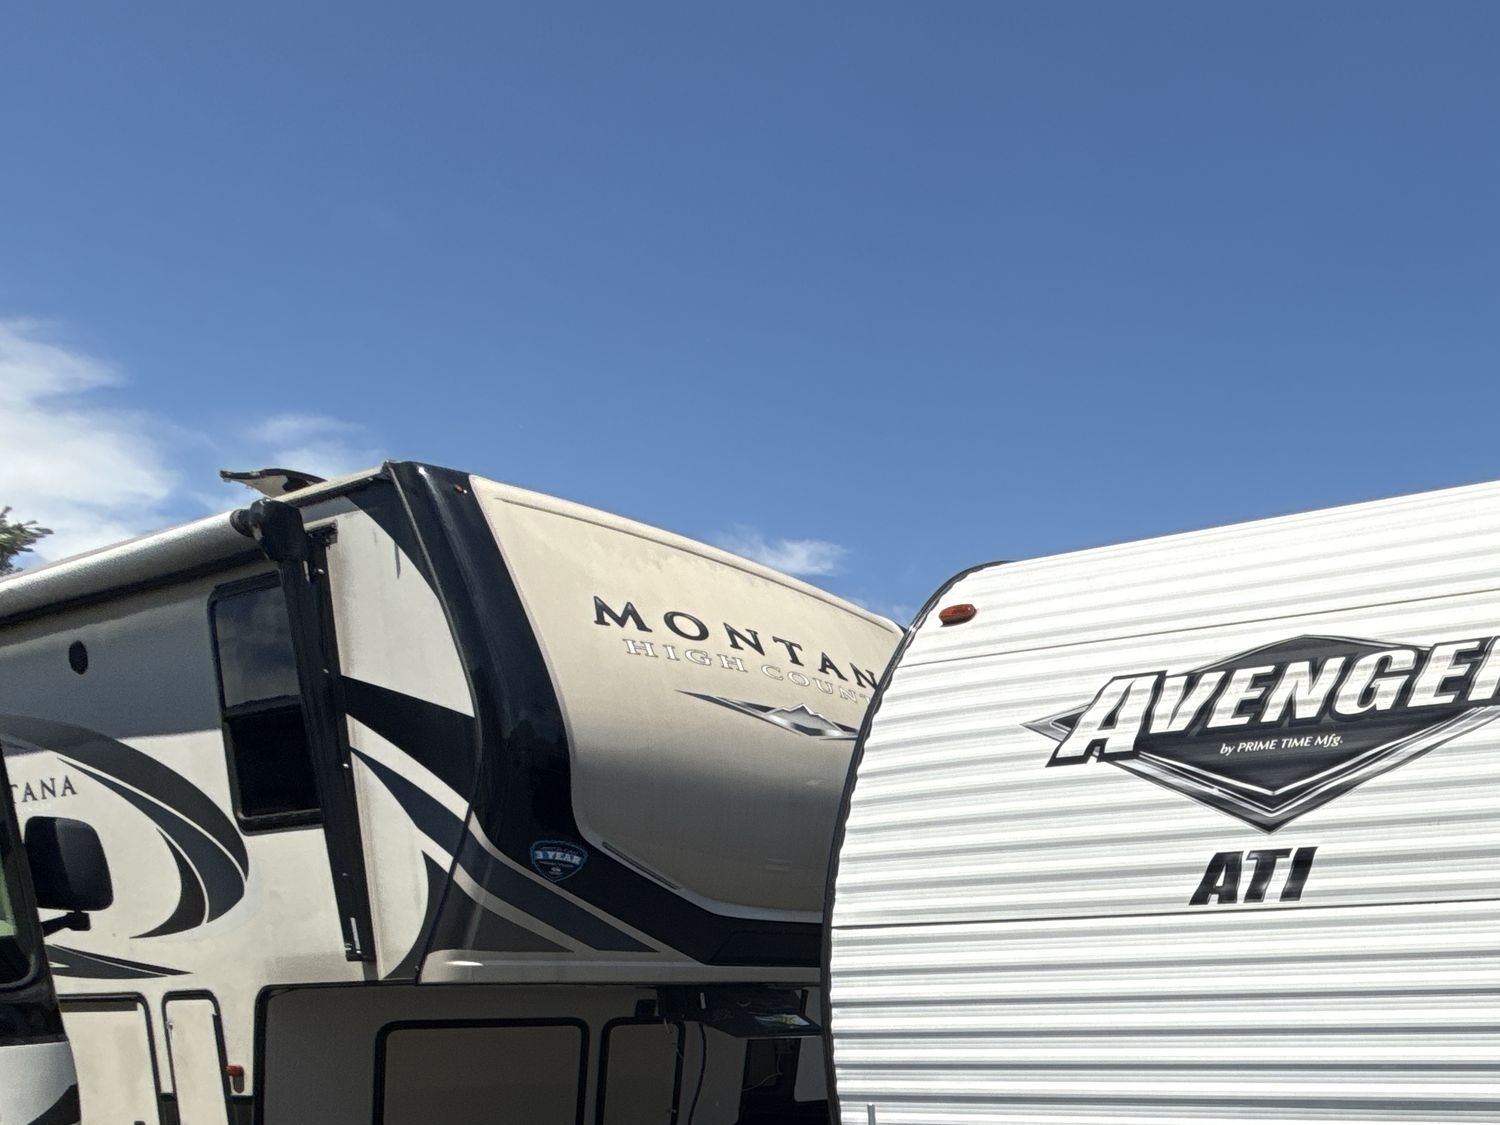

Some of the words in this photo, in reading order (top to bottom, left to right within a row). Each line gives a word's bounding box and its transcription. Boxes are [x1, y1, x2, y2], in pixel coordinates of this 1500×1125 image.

[594, 596, 879, 690] MONTAN
[622, 638, 749, 673] HIGH
[1219, 743, 1236, 757] by
[1236, 739, 1278, 752] PRIME
[1281, 736, 1313, 749] TIME
[1314, 733, 1344, 748] Mfg.
[545, 850, 582, 866] YEAR
[1189, 846, 1318, 905] ATI
